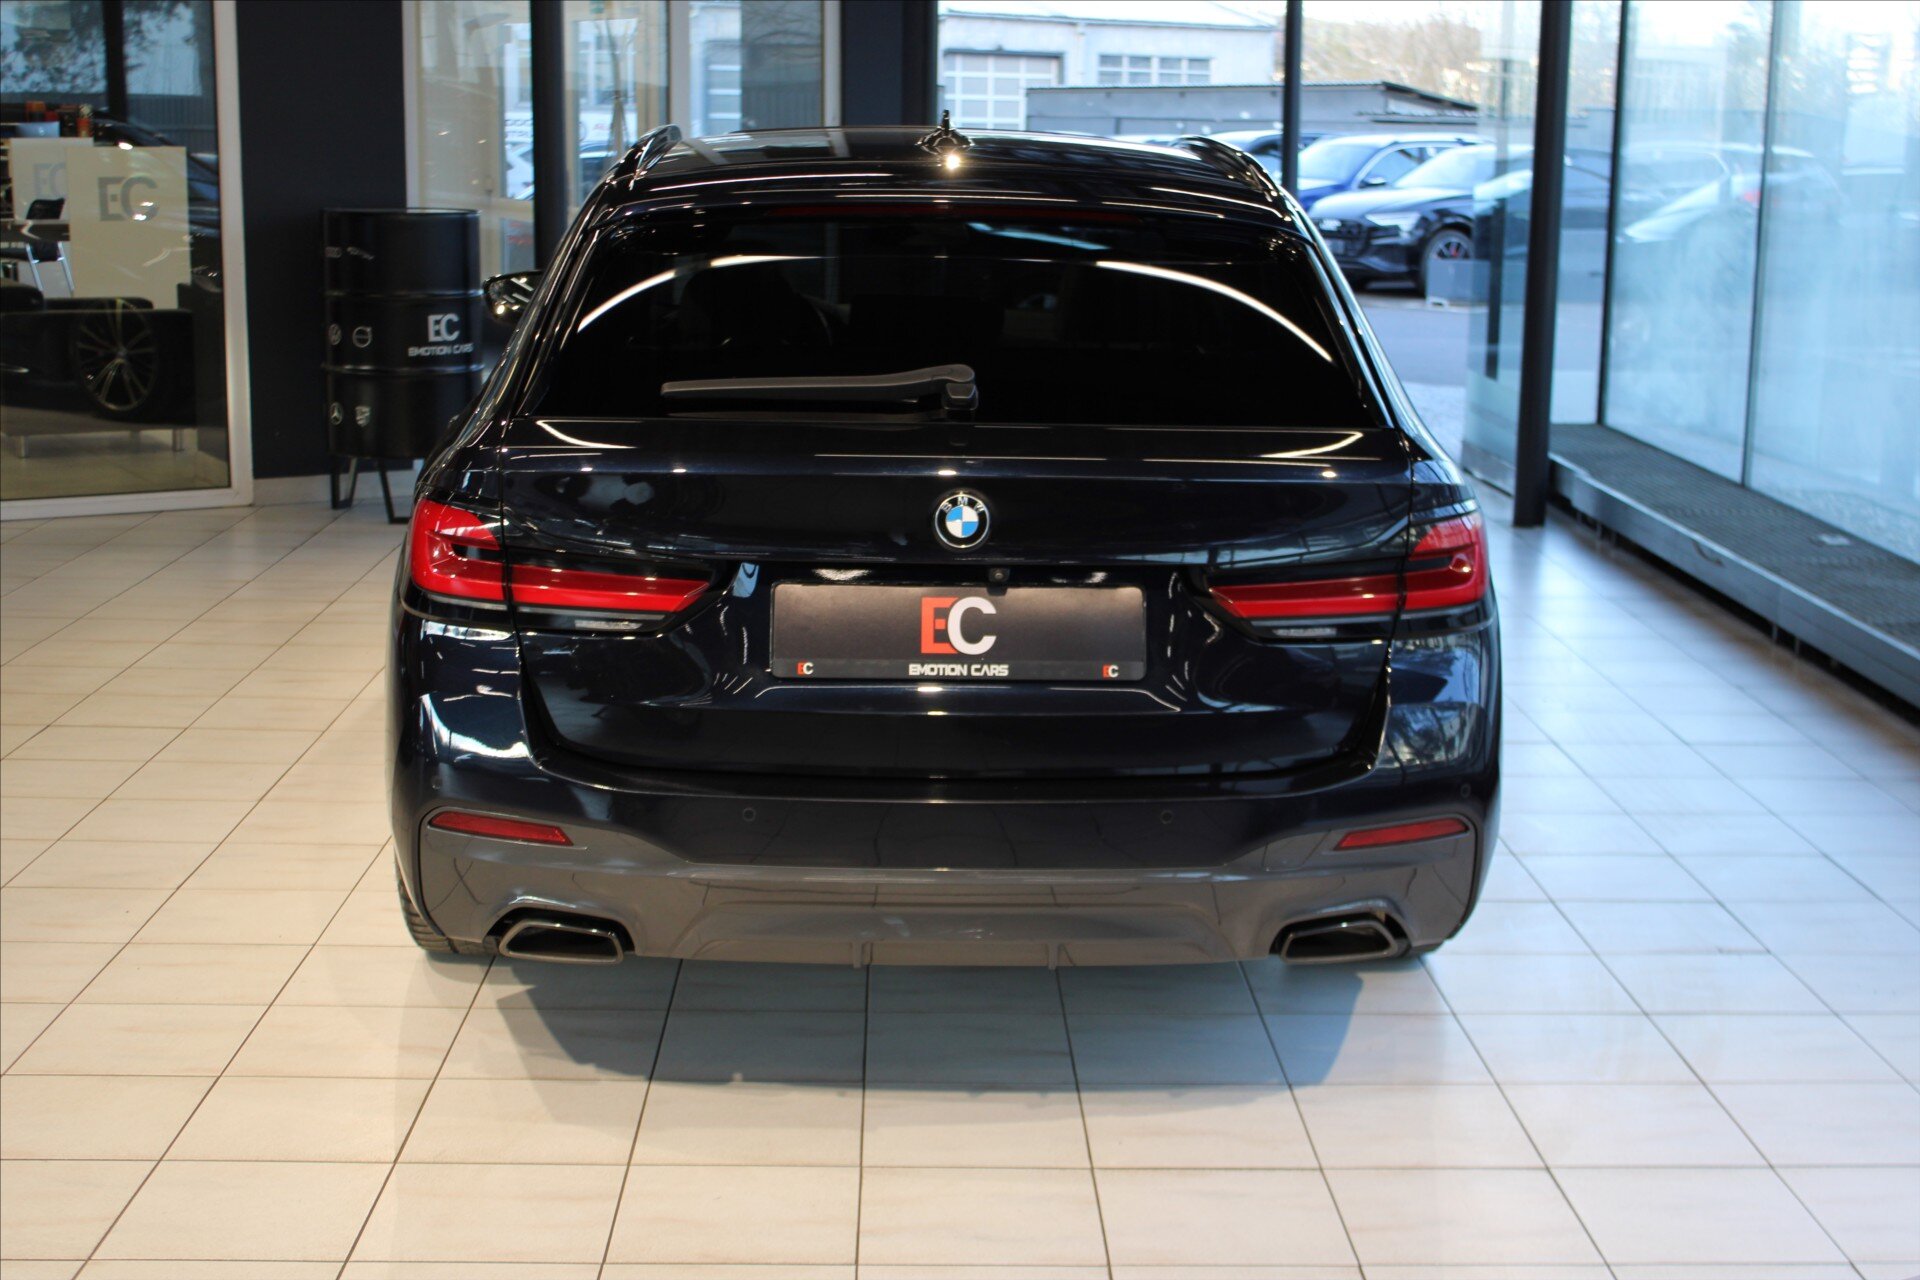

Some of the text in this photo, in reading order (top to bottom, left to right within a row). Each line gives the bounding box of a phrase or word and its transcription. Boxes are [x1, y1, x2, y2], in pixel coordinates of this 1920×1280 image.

[98, 176, 160, 222] EC
[427, 312, 460, 342] EC
[940, 496, 985, 514] BMW
[921, 596, 997, 655] EC
[797, 662, 814, 675] EC
[909, 664, 1009, 677] EMOTION CARS
[1103, 664, 1119, 678] EC
